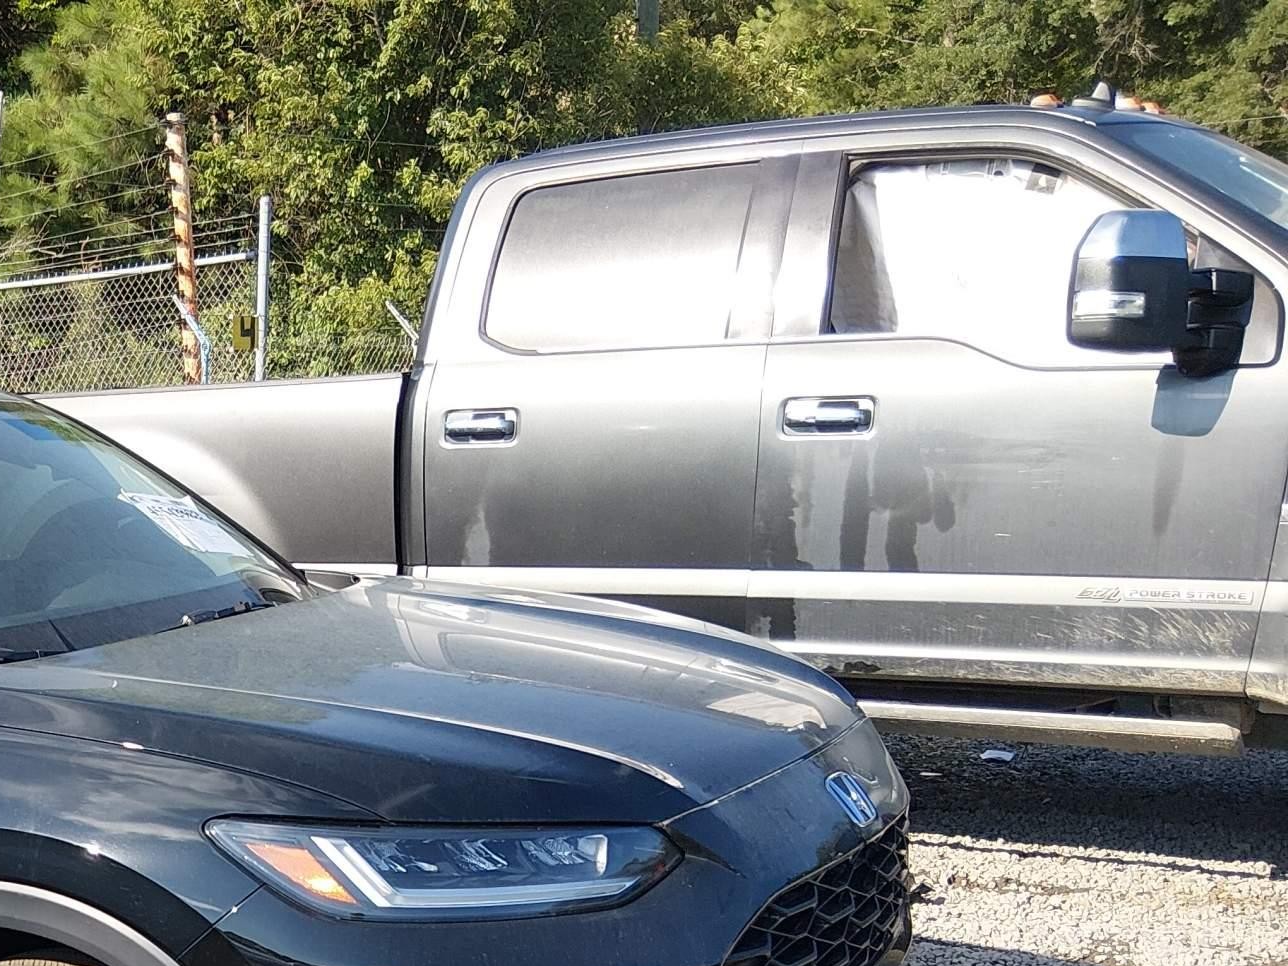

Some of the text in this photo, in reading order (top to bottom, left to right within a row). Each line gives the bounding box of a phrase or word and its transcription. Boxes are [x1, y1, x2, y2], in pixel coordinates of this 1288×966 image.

[240, 315, 256, 350] 4
[1128, 589, 1181, 599] POWER
[1186, 591, 1249, 601] STROKE
